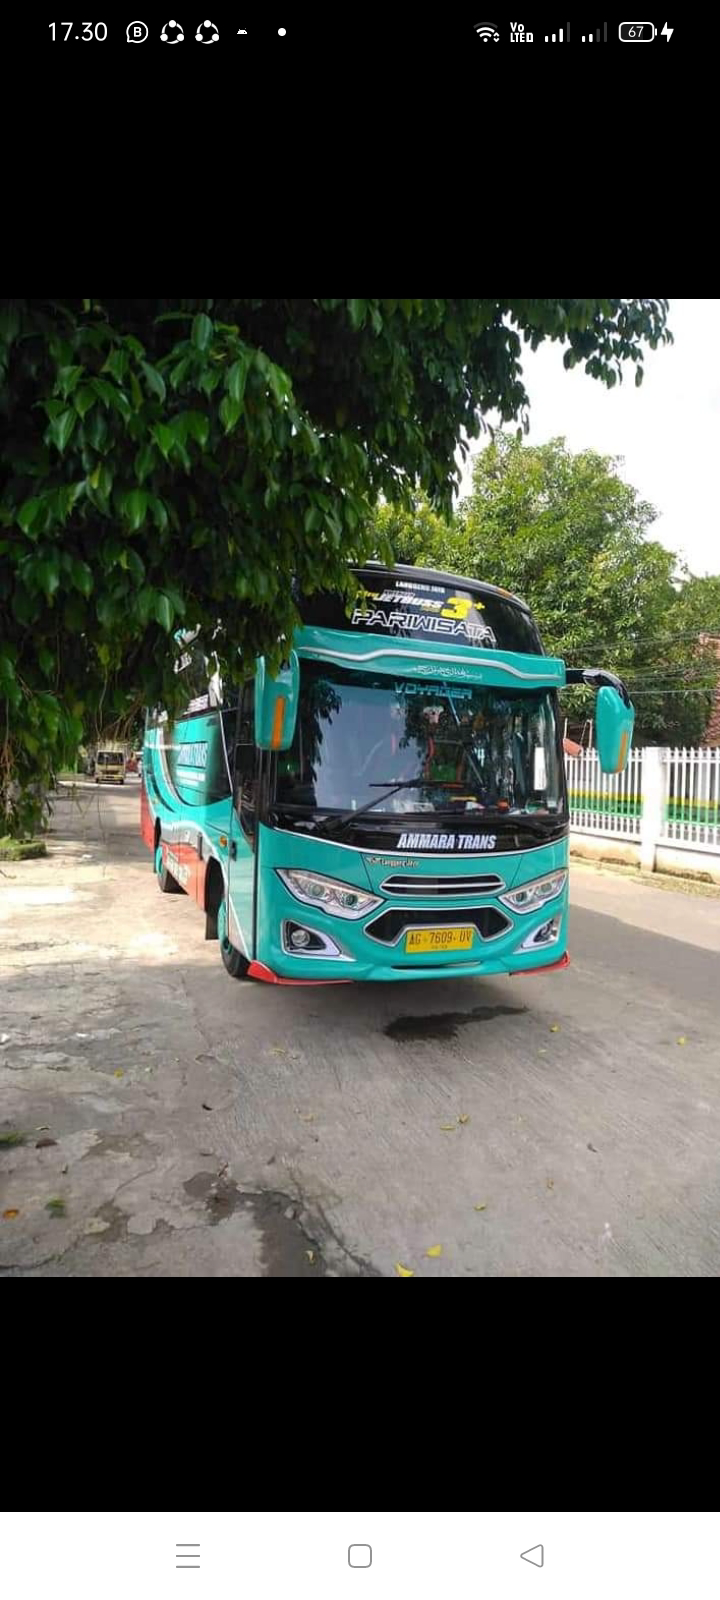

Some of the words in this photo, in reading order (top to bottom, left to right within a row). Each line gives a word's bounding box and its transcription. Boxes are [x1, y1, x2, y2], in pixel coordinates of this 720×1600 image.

[351, 608, 497, 642] PARIWISATA
[396, 832, 454, 849] AMMARA
[455, 834, 497, 850] TRANS
[408, 933, 421, 945] AG
[429, 930, 453, 945] 7609
